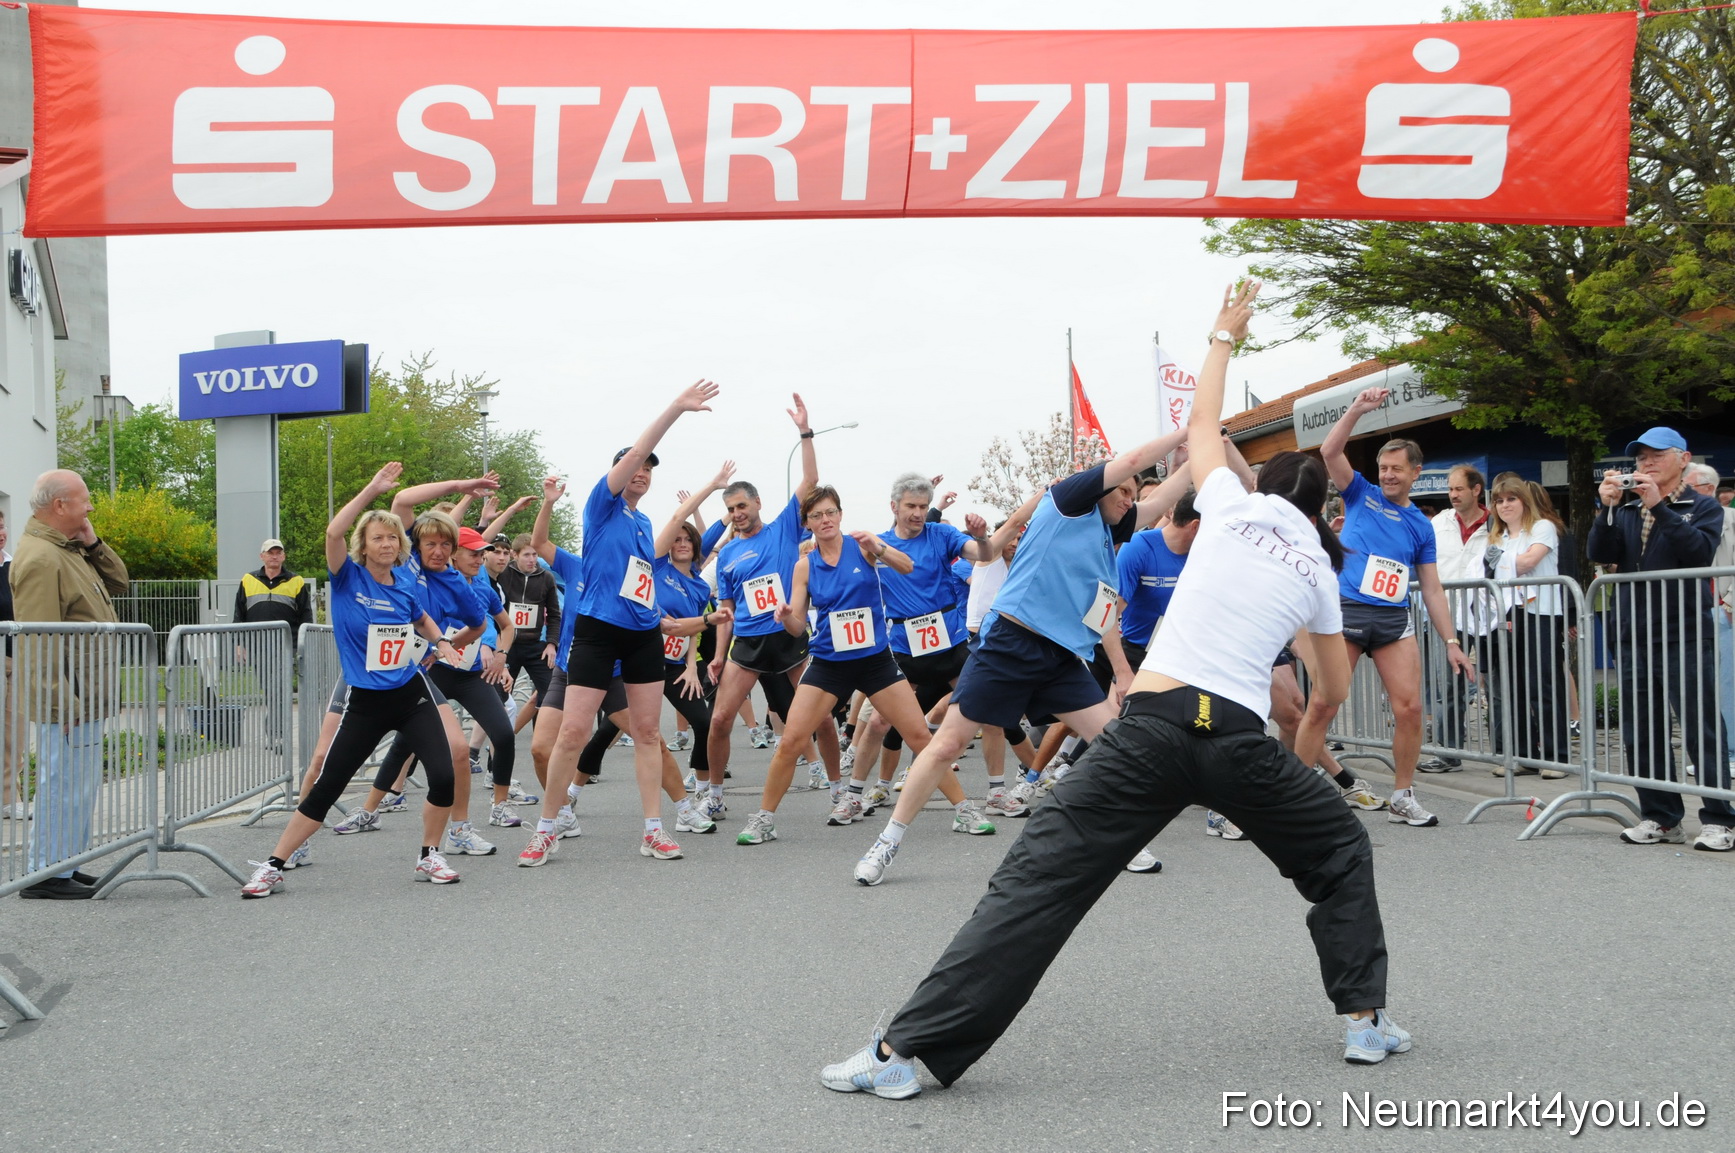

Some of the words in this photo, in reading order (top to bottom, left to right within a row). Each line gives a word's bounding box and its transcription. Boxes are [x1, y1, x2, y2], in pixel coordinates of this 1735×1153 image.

[193, 363, 319, 395] VOLVO
[1225, 518, 1318, 588] ZEITLOS
[1376, 559, 1396, 567] MEYER
[634, 573, 652, 602] 21
[1372, 570, 1399, 598] 66
[754, 586, 778, 610] 64
[515, 611, 529, 626] 81
[911, 617, 930, 625] MEYER
[1100, 603, 1112, 628] 1
[843, 620, 866, 645] 10
[916, 626, 940, 650] 73
[379, 640, 406, 667] 67
[664, 635, 684, 658] 65
